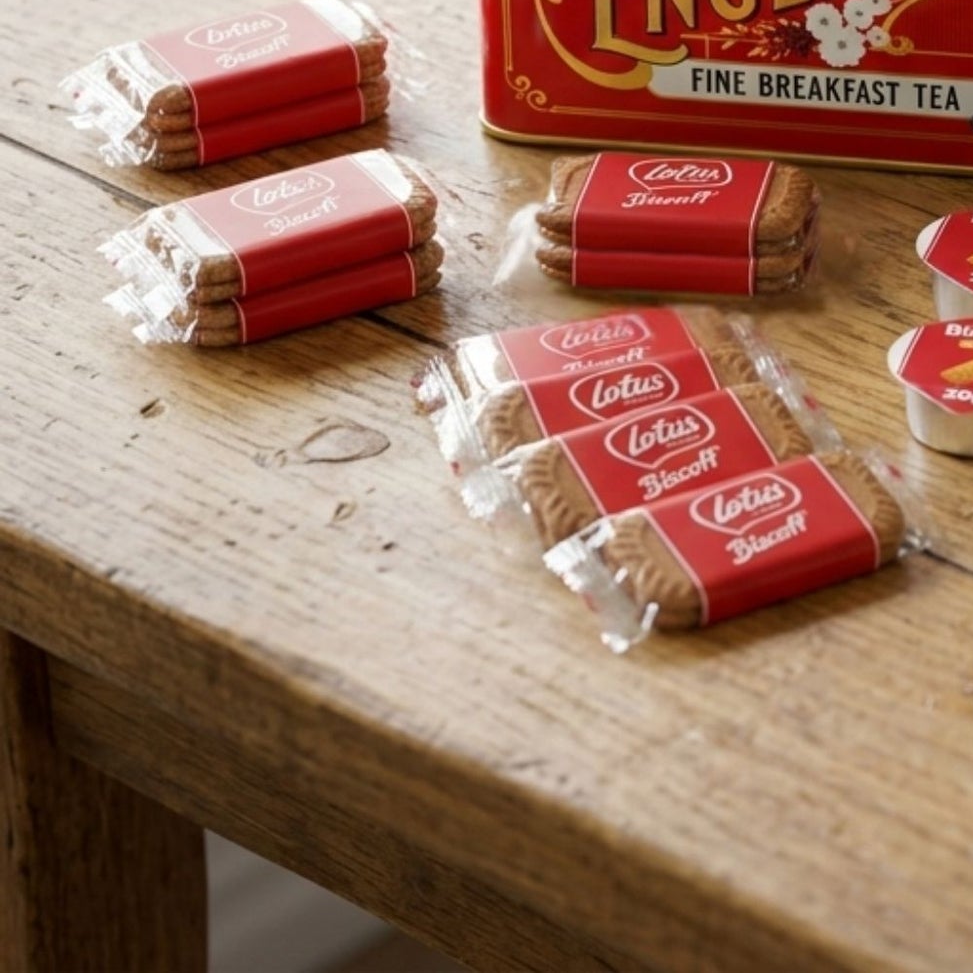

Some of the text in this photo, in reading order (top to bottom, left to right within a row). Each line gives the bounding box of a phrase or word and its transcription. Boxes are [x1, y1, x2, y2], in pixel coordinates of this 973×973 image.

[691, 68, 962, 112] FINE BREAKFAST TEA
[591, 373, 665, 410] Lotus
[628, 415, 700, 457] Lotus
[637, 446, 719, 501] Biscoff
[713, 482, 786, 524] Lotus
[725, 511, 807, 565] Biscoff
